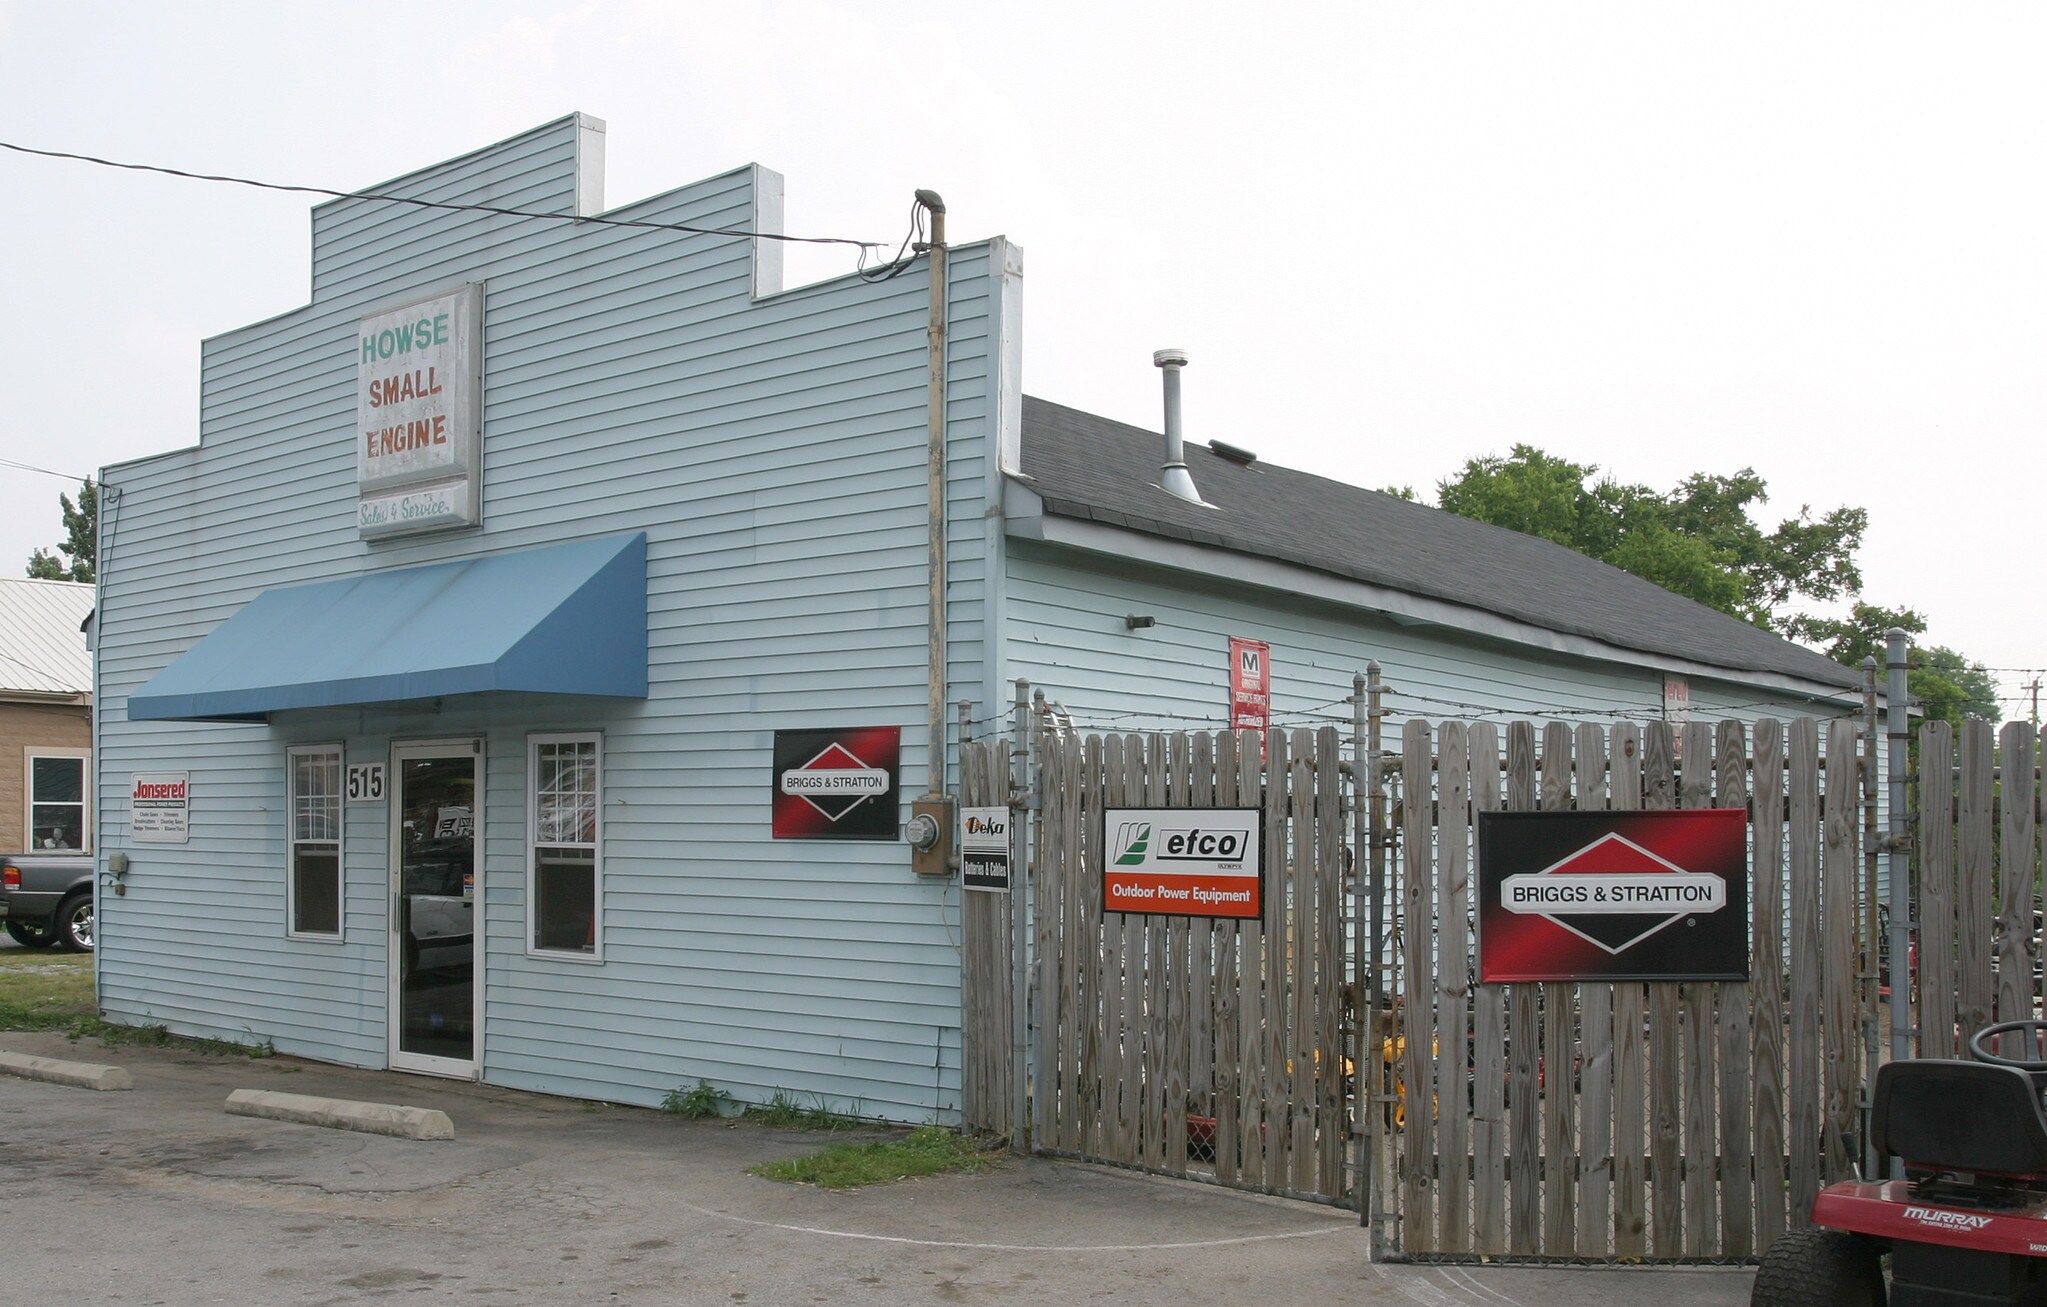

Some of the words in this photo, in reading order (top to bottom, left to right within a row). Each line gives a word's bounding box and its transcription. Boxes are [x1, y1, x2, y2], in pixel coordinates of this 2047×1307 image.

[362, 314, 449, 364] HOWSE
[369, 367, 442, 408] SMALL
[366, 414, 447, 458] ENGINE
[360, 503, 388, 525] Sales
[391, 503, 397, 520] &
[402, 497, 450, 519] Service
[1242, 652, 1259, 671] M
[133, 779, 186, 798] Jonsered
[349, 767, 382, 798] 515
[787, 777, 822, 788] BRIGGS
[824, 778, 832, 788] &
[833, 776, 882, 788] STRATTON
[967, 816, 1005, 836] Deka
[1167, 829, 1238, 855] efco
[1112, 883, 1155, 898] Outdoor
[1158, 885, 1190, 900] Power
[1193, 887, 1251, 905] Equipment
[1513, 886, 1588, 902] BRIGGS
[1594, 886, 1607, 902] &
[1612, 885, 1712, 902] STRATTON
[1904, 1207, 1994, 1228] MURRAY
